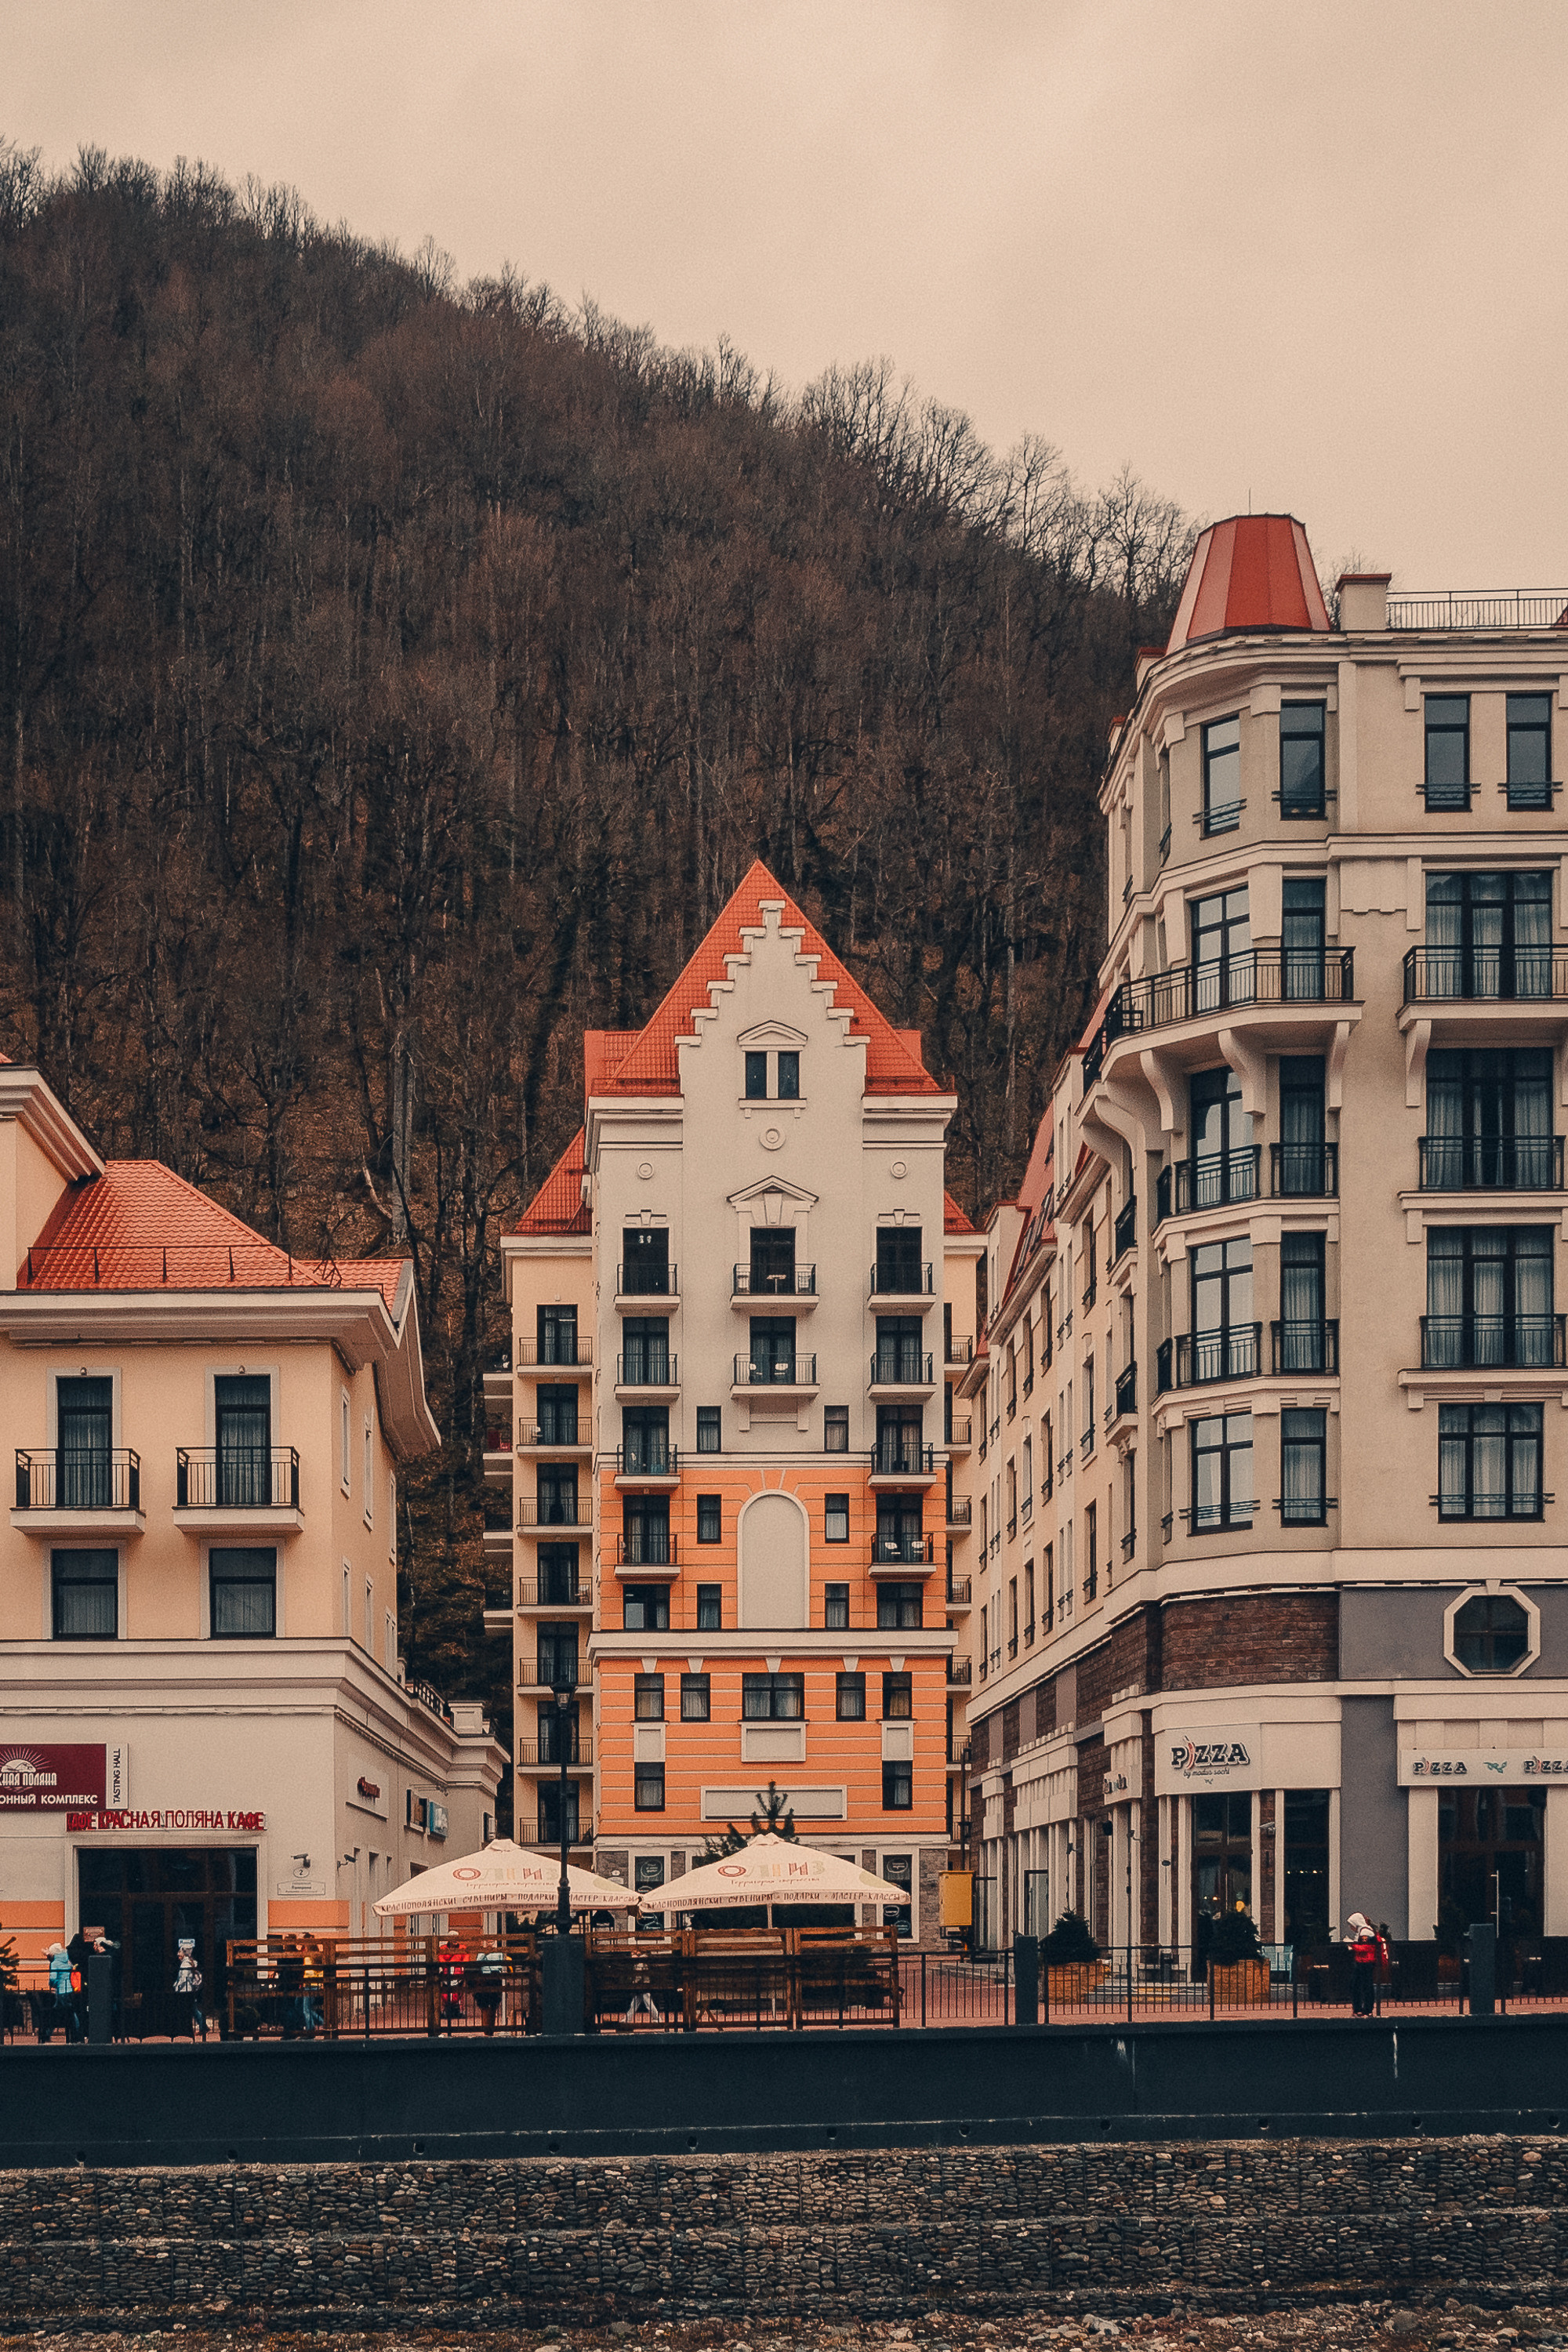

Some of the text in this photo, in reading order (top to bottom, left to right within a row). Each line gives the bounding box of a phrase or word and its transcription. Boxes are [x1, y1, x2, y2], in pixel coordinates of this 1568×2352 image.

[1171, 1737, 1250, 1769] PIZZA
[1413, 1758, 1467, 1774] PIZZA
[22, 1772, 57, 1786] ПОЛЯНА
[41, 1795, 98, 1805] КОМПЛЕКС
[98, 1810, 161, 1829] КРАСНАЯ
[165, 1809, 224, 1828] ПОЛЯНА
[227, 1810, 265, 1830] КАФЕ
[517, 1893, 555, 1902] ПОДАРКИ
[783, 1892, 820, 1902] ПОДАРКИ
